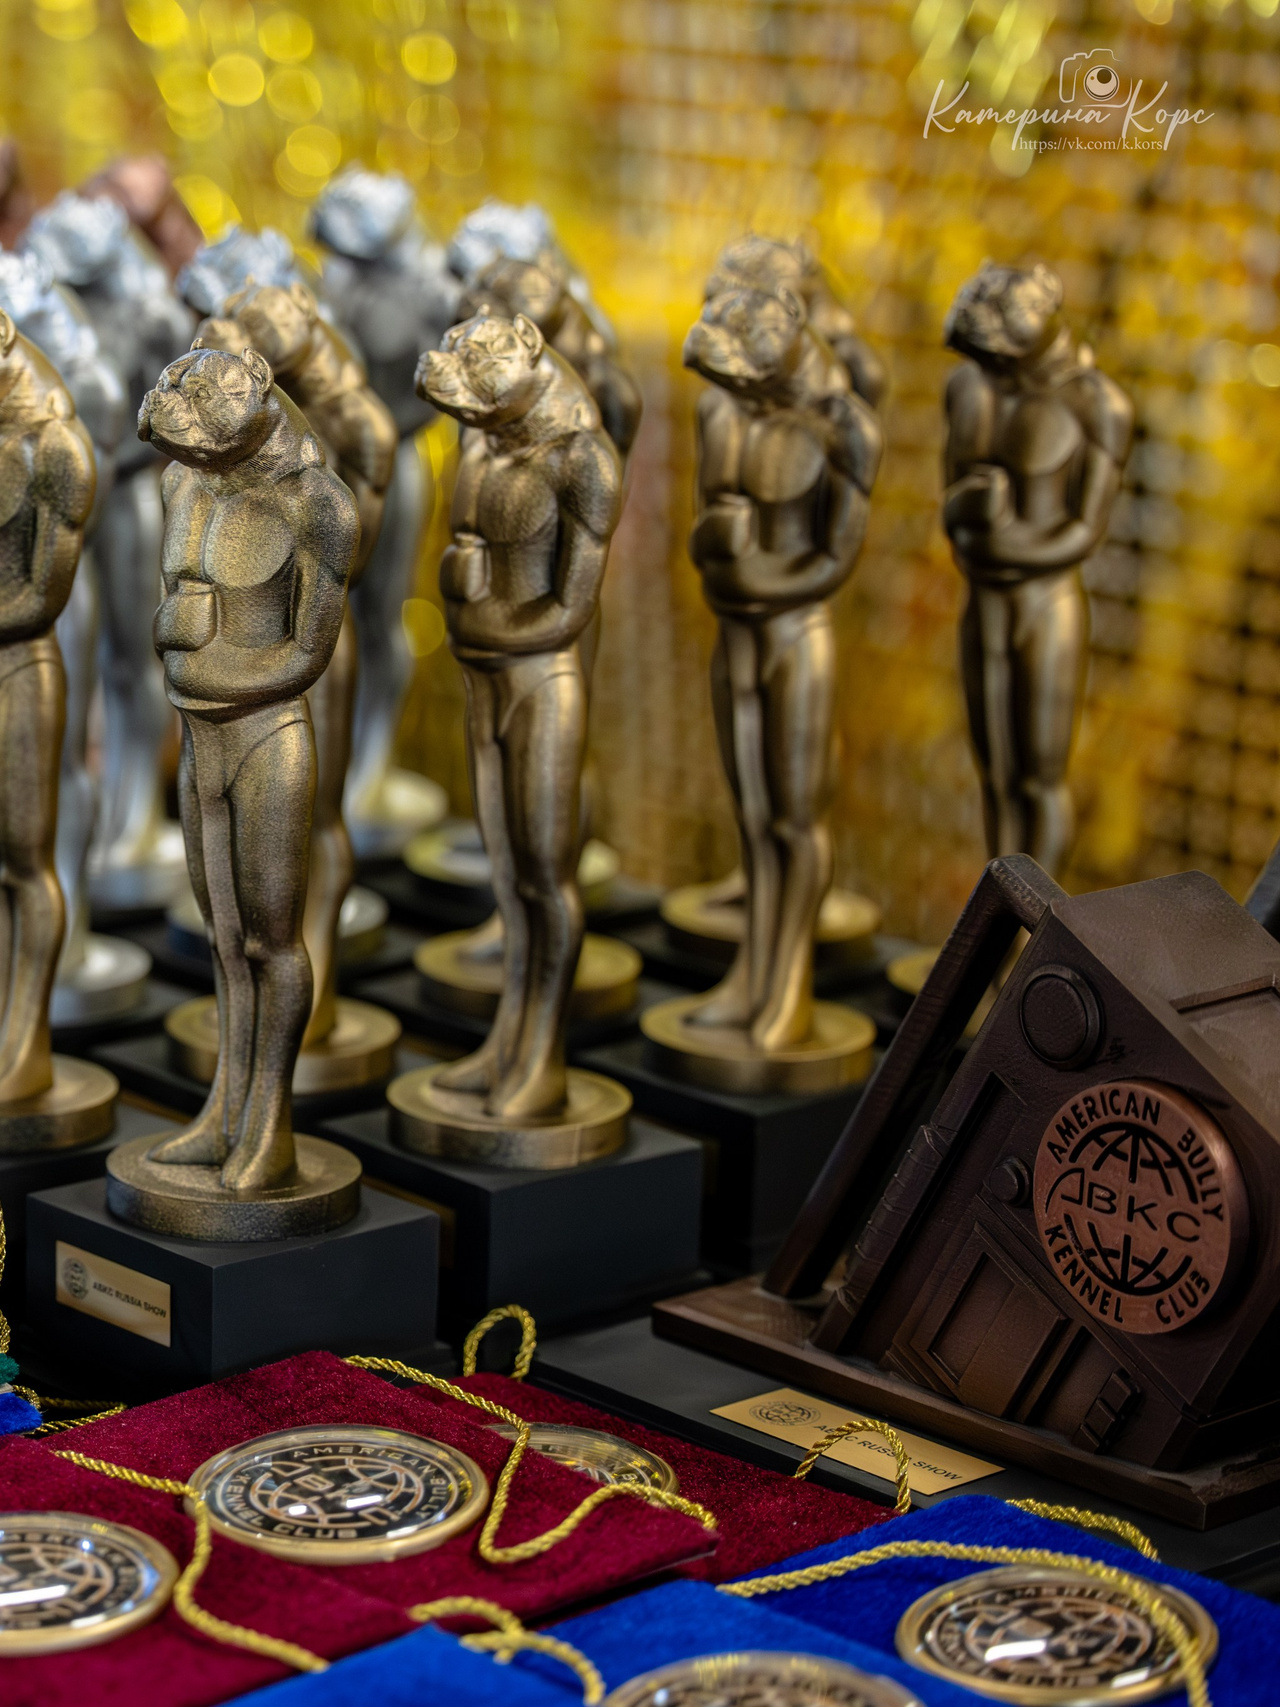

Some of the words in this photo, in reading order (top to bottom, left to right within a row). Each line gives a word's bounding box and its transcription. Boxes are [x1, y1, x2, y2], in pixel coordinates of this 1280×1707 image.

[1047, 1089, 1161, 1164] AMERICAN
[1177, 1128, 1224, 1222] BULLY
[1044, 1224, 1124, 1323] KENNEL
[1155, 1270, 1211, 1324] CLUB
[293, 1445, 438, 1474] AMERICAN
[913, 1460, 963, 1480] SHOW
[226, 1474, 265, 1527] KENNEL
[272, 1522, 358, 1539] CLUB
